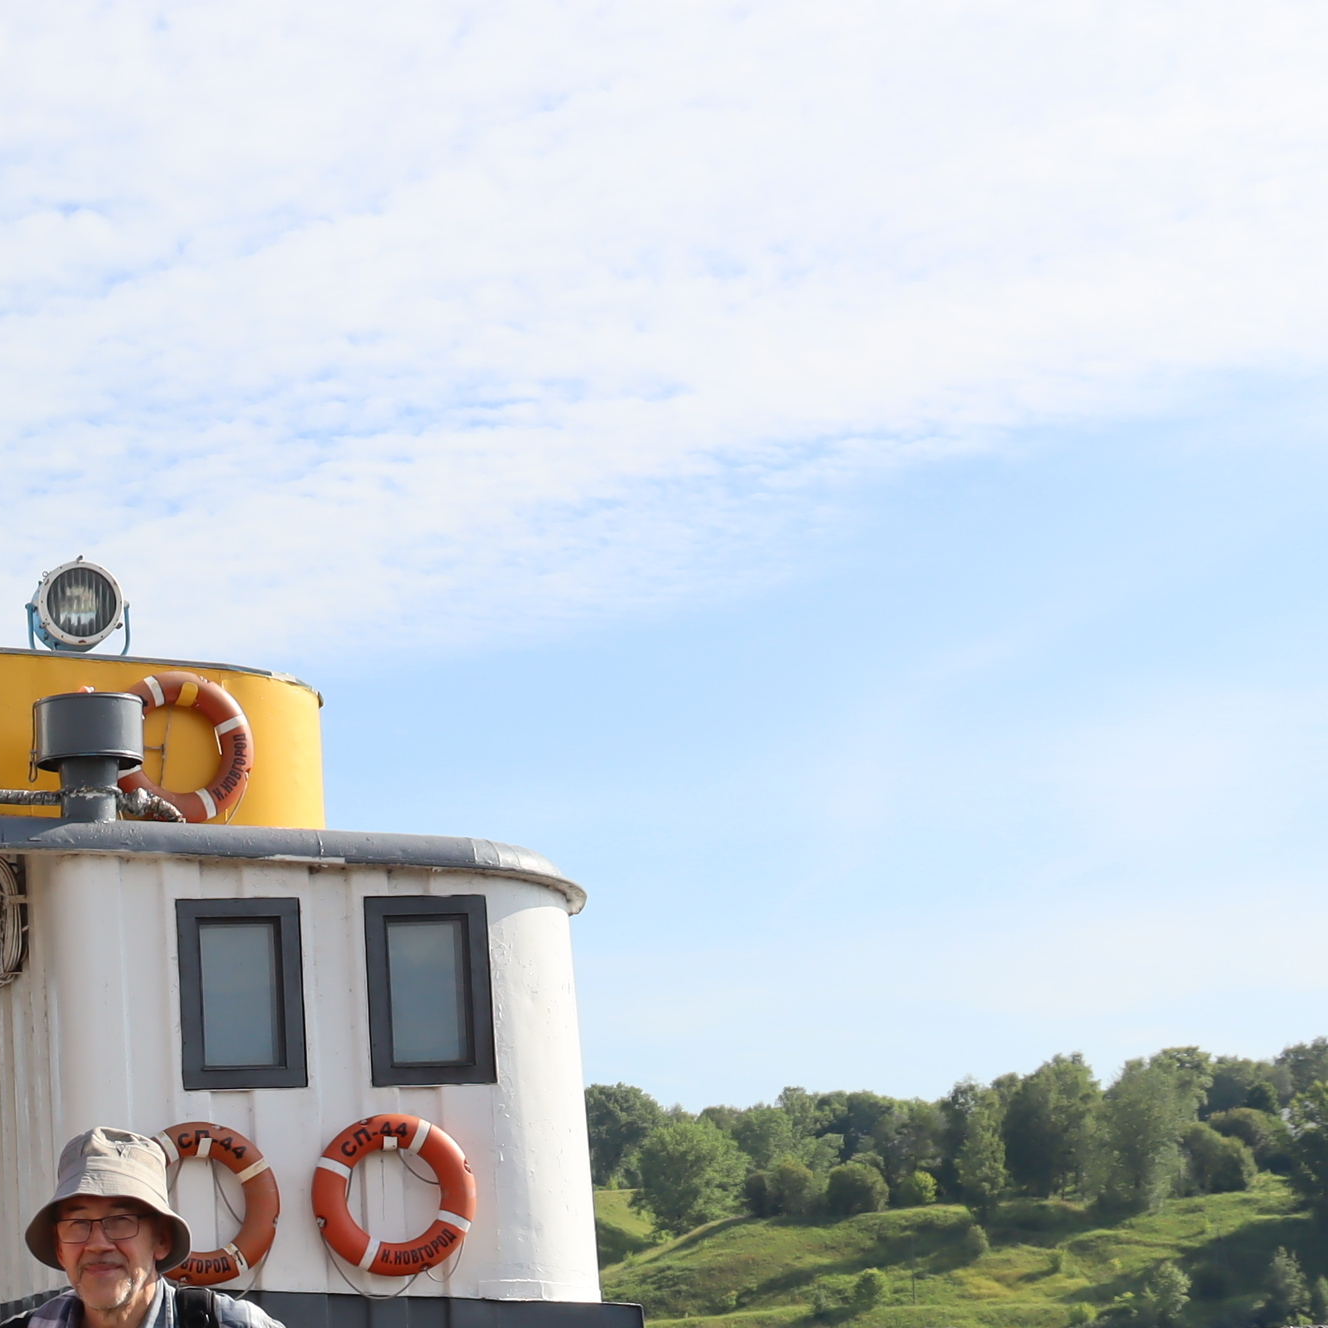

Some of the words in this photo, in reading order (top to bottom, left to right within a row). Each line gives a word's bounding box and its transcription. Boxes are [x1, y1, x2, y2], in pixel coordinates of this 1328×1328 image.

[339, 1121, 409, 1158] СП-44
[380, 1227, 458, 1265] Н.НОВГОРОД
[181, 1256, 232, 1276] ВГОРОД
